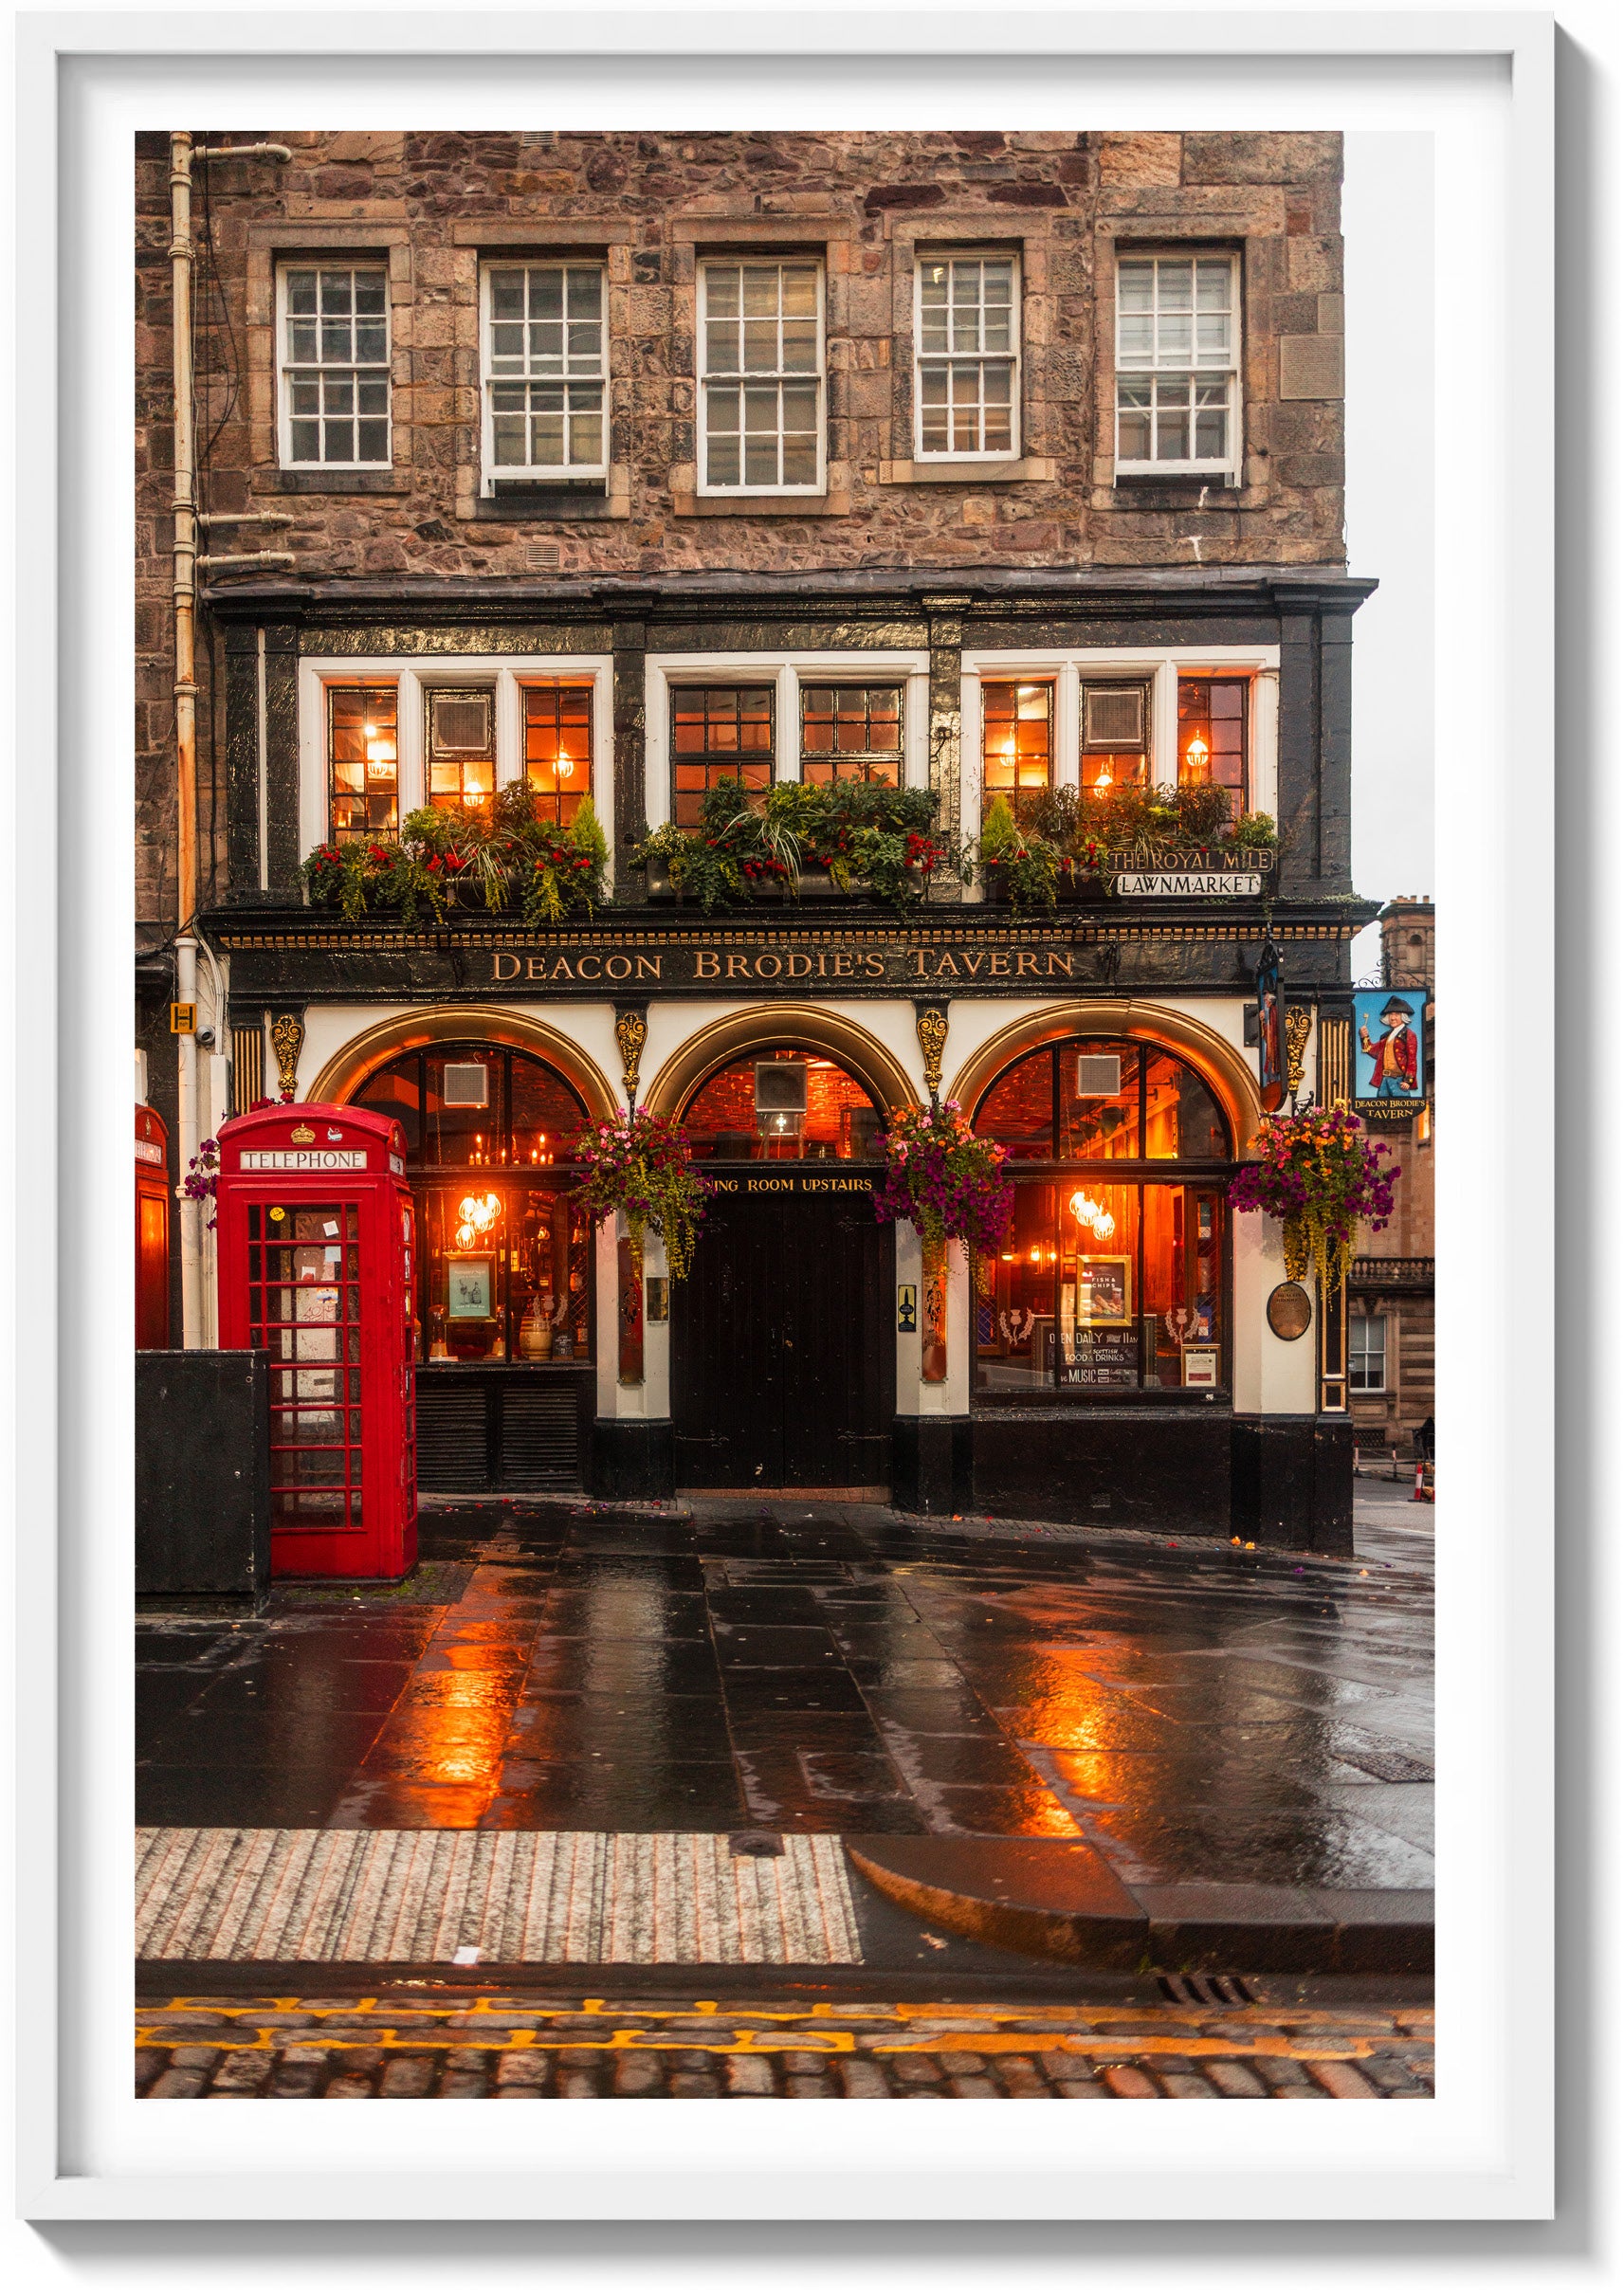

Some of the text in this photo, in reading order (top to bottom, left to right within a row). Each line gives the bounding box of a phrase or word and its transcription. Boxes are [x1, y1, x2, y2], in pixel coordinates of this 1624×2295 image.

[1110, 851, 1268, 869] THE ROYAL MILE
[1122, 876, 1257, 893] LAWNMARKET
[491, 949, 1074, 981] DEACON BRODIE'S TAVERN
[1355, 1100, 1426, 1109] DEACON BRODIE'S
[1366, 1109, 1414, 1120] TAVERN
[245, 1152, 363, 1169] TELEPHONE
[747, 1178, 794, 1192] ROOM
[802, 1178, 872, 1192] UPSTAIRS
[1049, 1332, 1072, 1344] OEN
[1076, 1332, 1104, 1344] DAILY
[1065, 1354, 1088, 1362] FOOD
[1095, 1354, 1125, 1362] DRINKS
[1068, 1369, 1097, 1384] MUSIC
